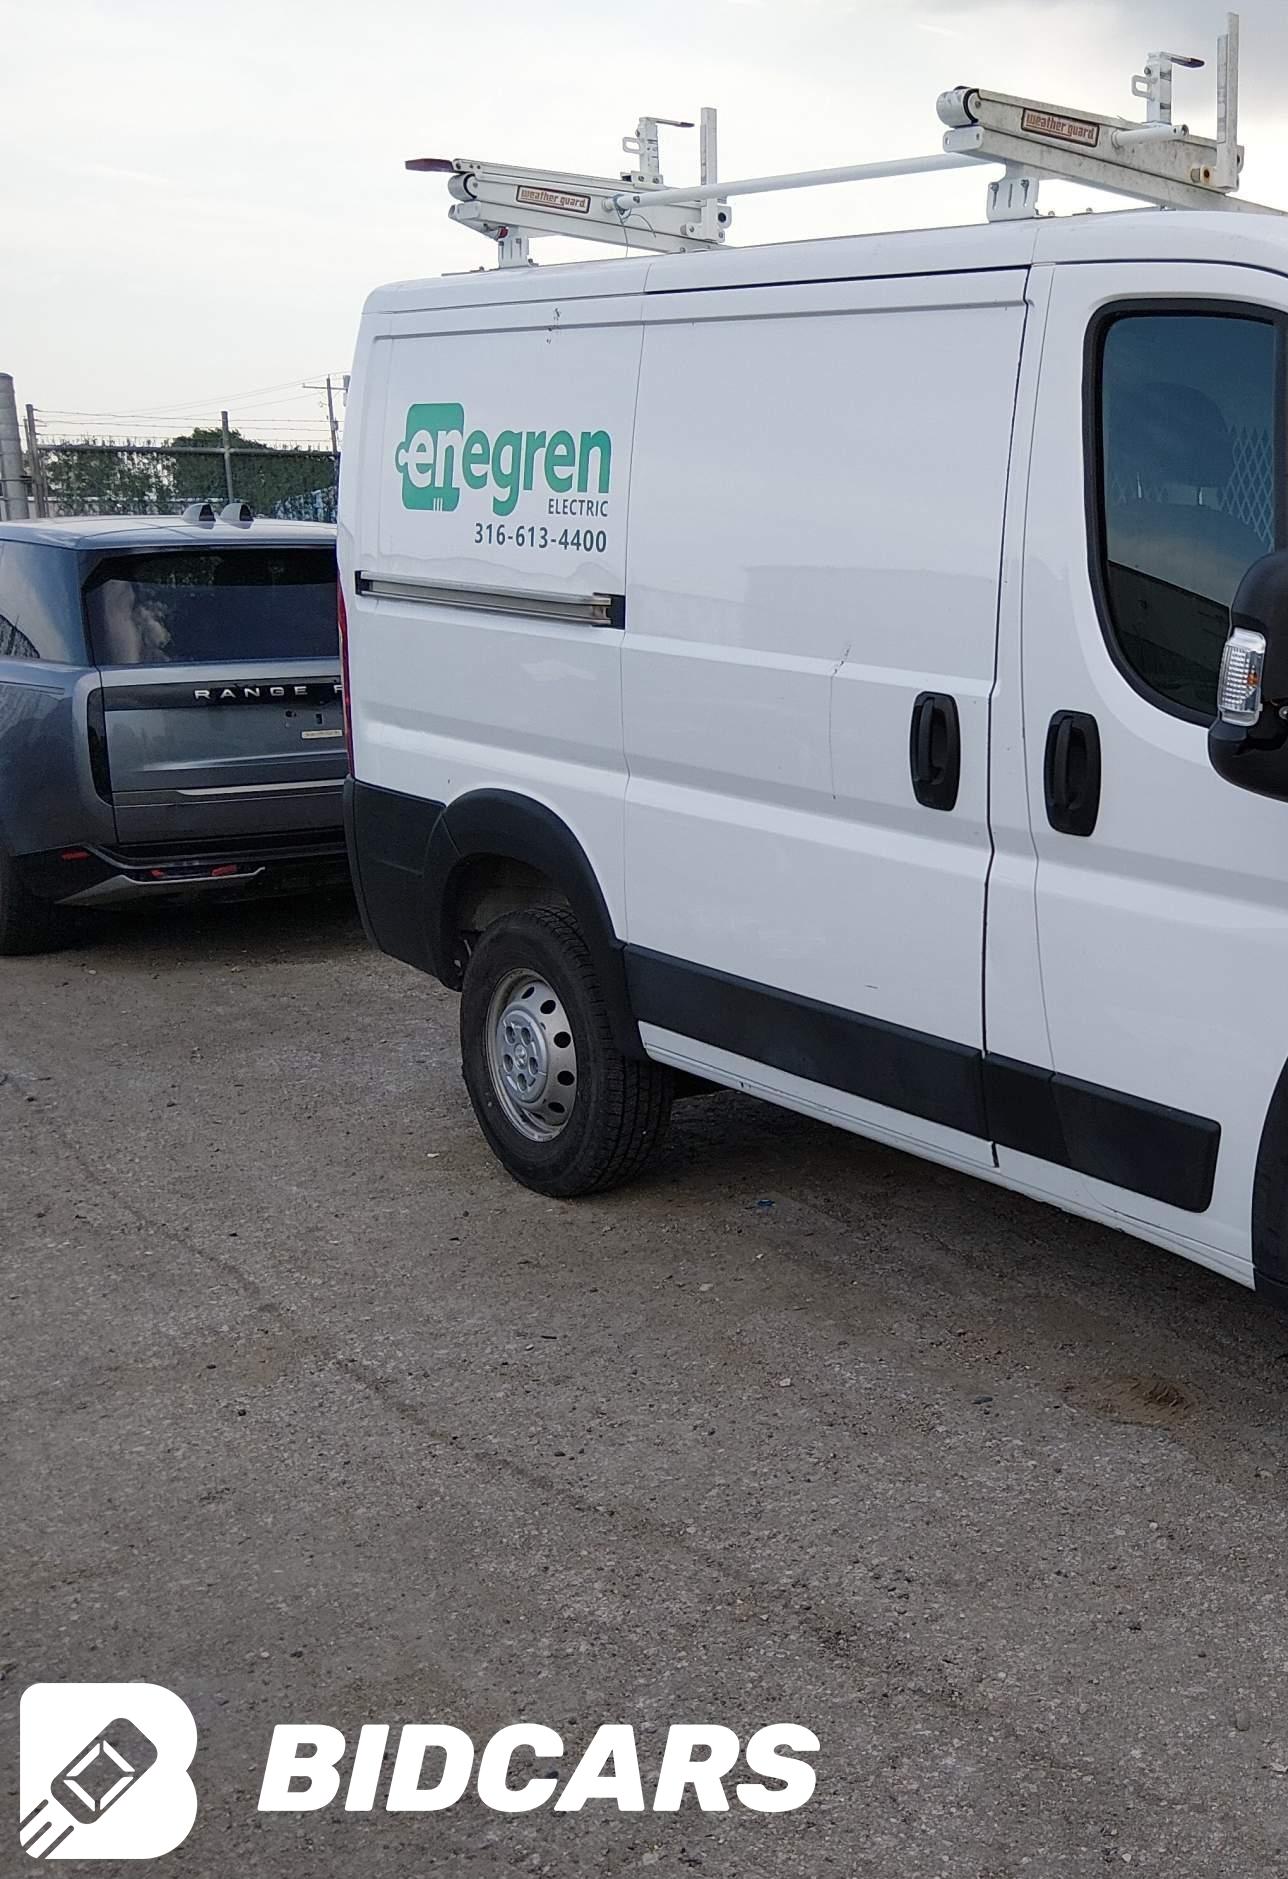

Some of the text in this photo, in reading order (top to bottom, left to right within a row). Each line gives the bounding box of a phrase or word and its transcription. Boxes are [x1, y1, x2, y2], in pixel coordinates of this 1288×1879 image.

[1027, 113, 1095, 139] weather guard
[402, 429, 612, 516] enegren
[548, 498, 609, 517] ELECTRIC
[474, 522, 607, 553] 316-613-4400
[194, 685, 308, 700] RANGE
